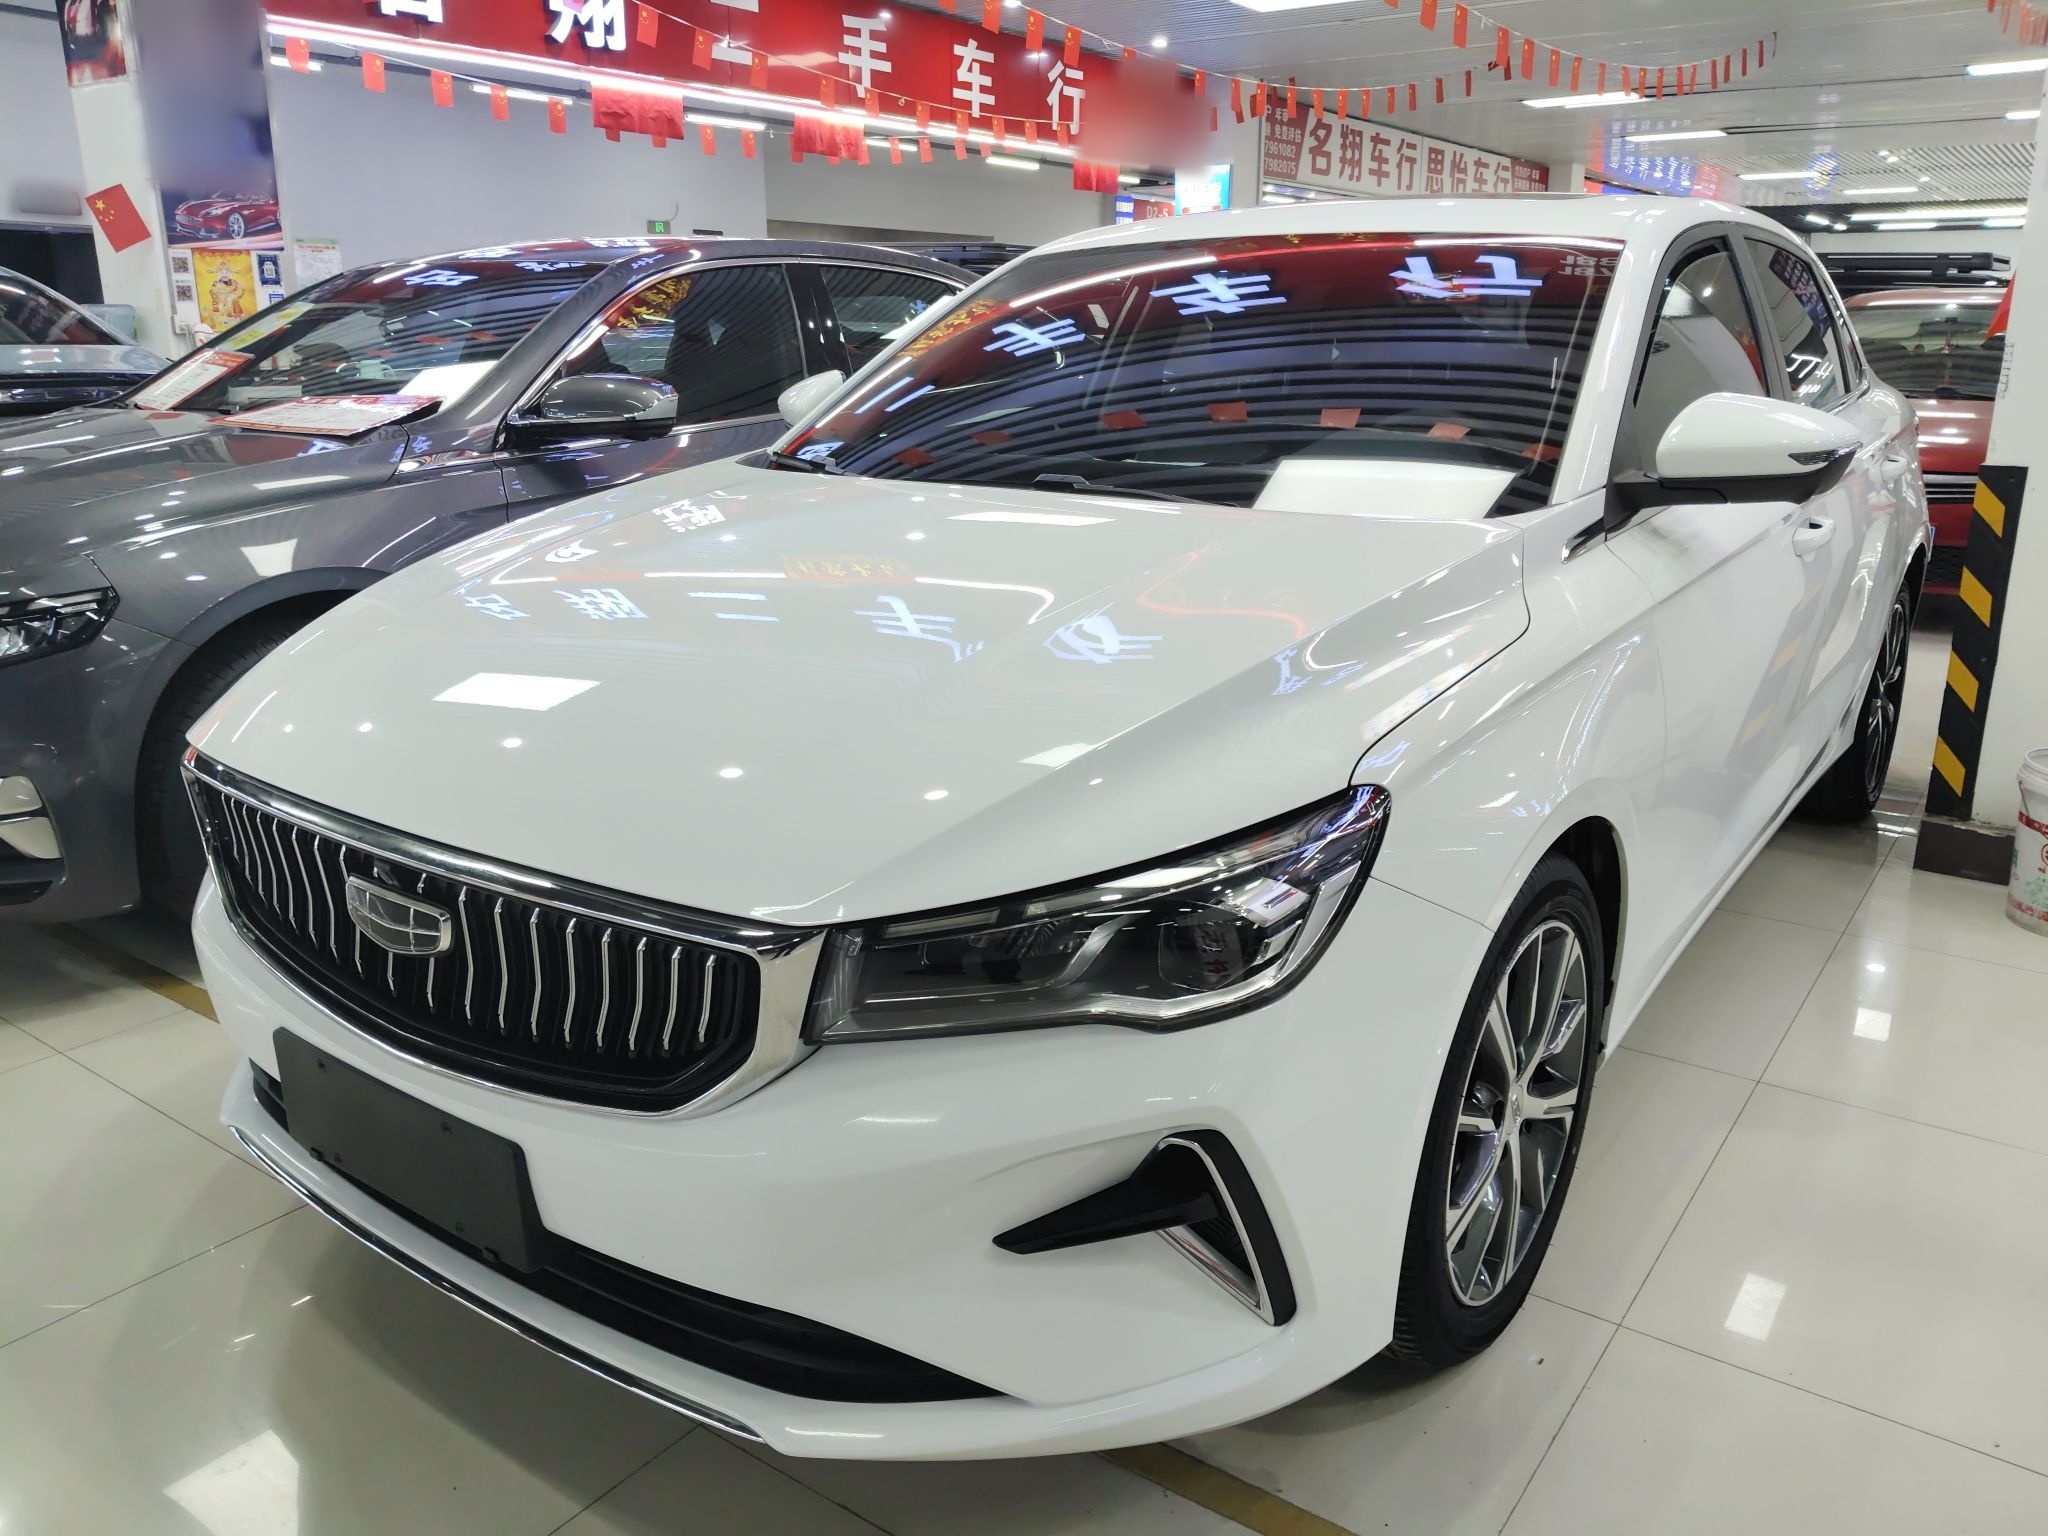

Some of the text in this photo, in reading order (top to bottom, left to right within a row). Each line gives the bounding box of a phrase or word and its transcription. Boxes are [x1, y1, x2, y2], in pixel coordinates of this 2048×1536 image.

[1308, 118, 1418, 191] 名翔车行
[1425, 146, 1510, 194] 思怡车行
